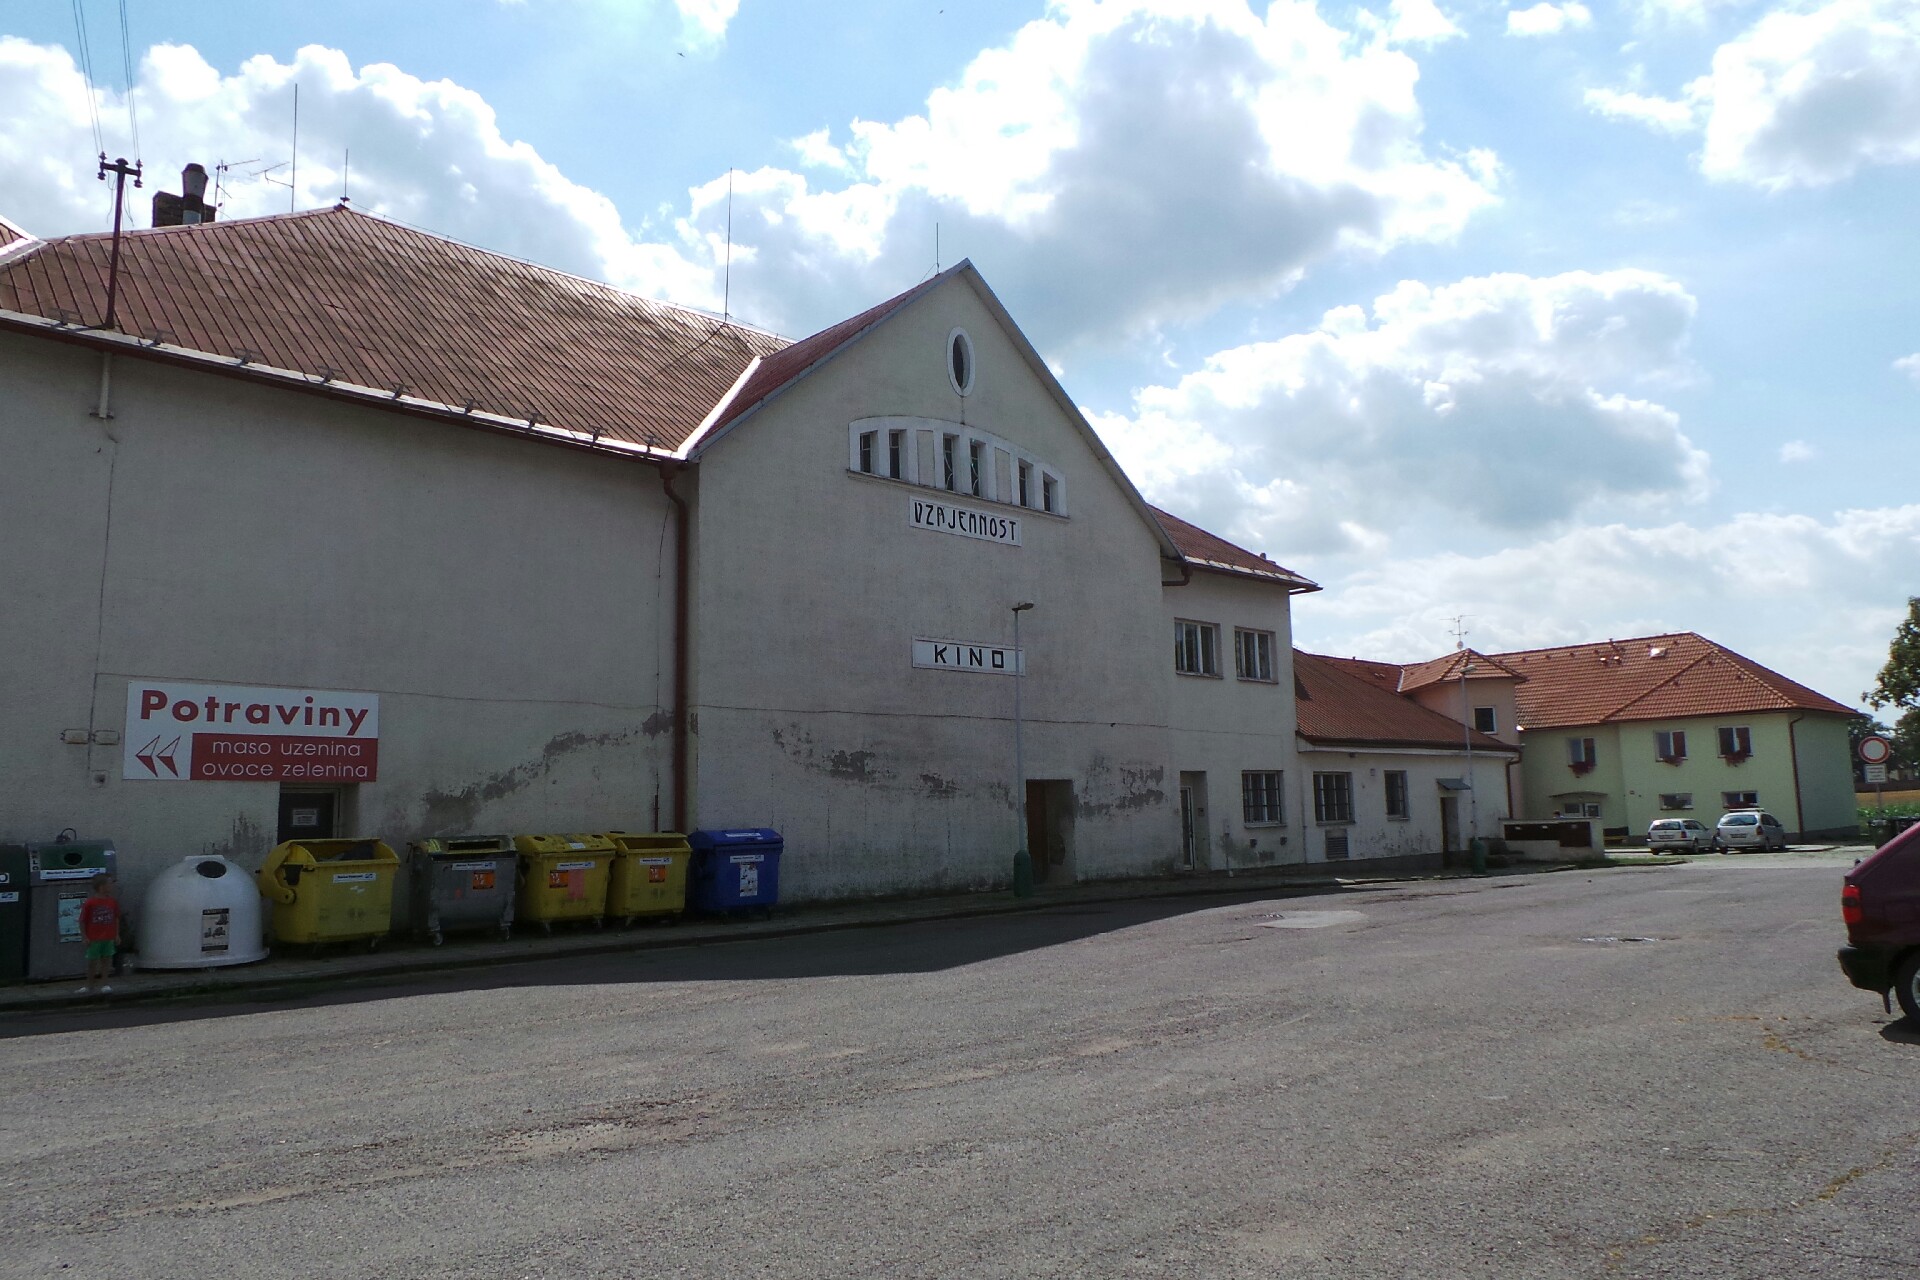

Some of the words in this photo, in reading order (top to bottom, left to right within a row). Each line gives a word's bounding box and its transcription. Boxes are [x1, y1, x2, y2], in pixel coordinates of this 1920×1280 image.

[934, 644, 1004, 668] KINO
[140, 689, 369, 736] Potraviny
[212, 740, 271, 755] maso
[280, 740, 361, 757] uzenina
[202, 762, 273, 776] ovoce
[282, 762, 368, 778] zelenina
